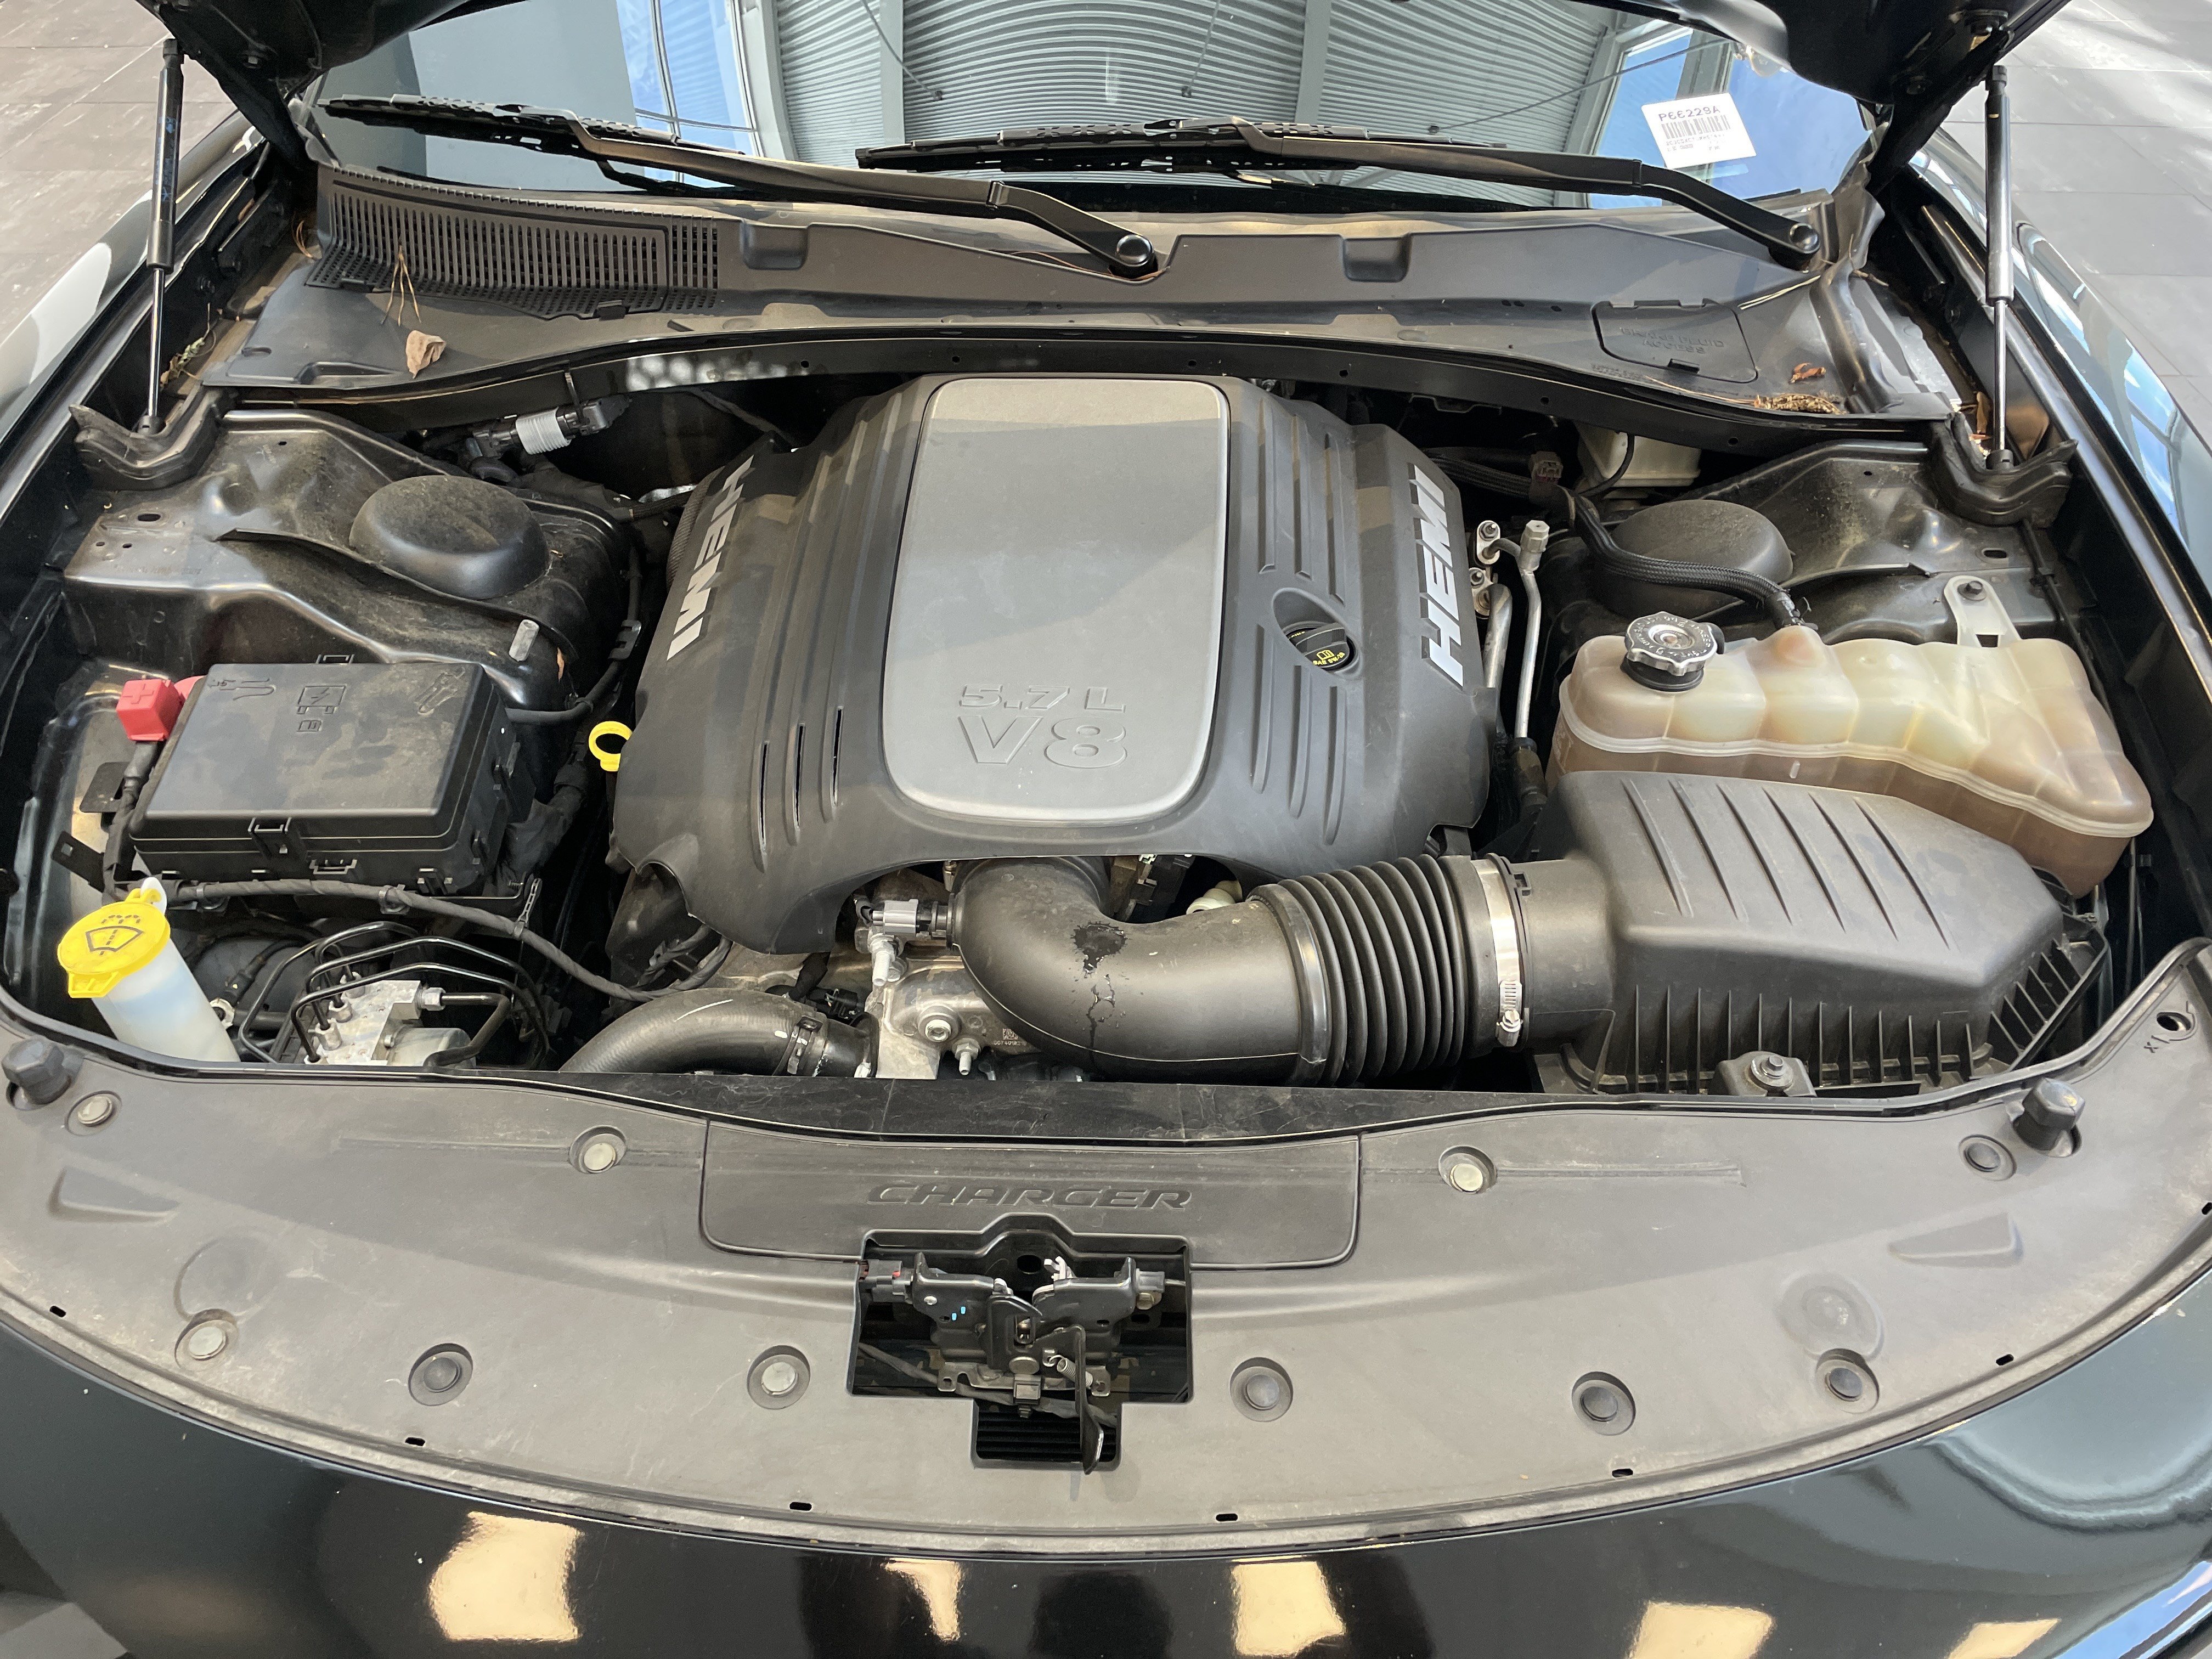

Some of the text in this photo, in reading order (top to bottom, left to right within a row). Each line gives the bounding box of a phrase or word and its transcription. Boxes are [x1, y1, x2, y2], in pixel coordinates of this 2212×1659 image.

[1642, 338, 1706, 354] ACCESS
[1679, 335, 1725, 348] FLUID
[667, 454, 754, 661] HEMI
[1413, 464, 1464, 687] HEMI
[957, 715, 1128, 769] V8
[867, 1182, 1193, 1210] CHARGER
